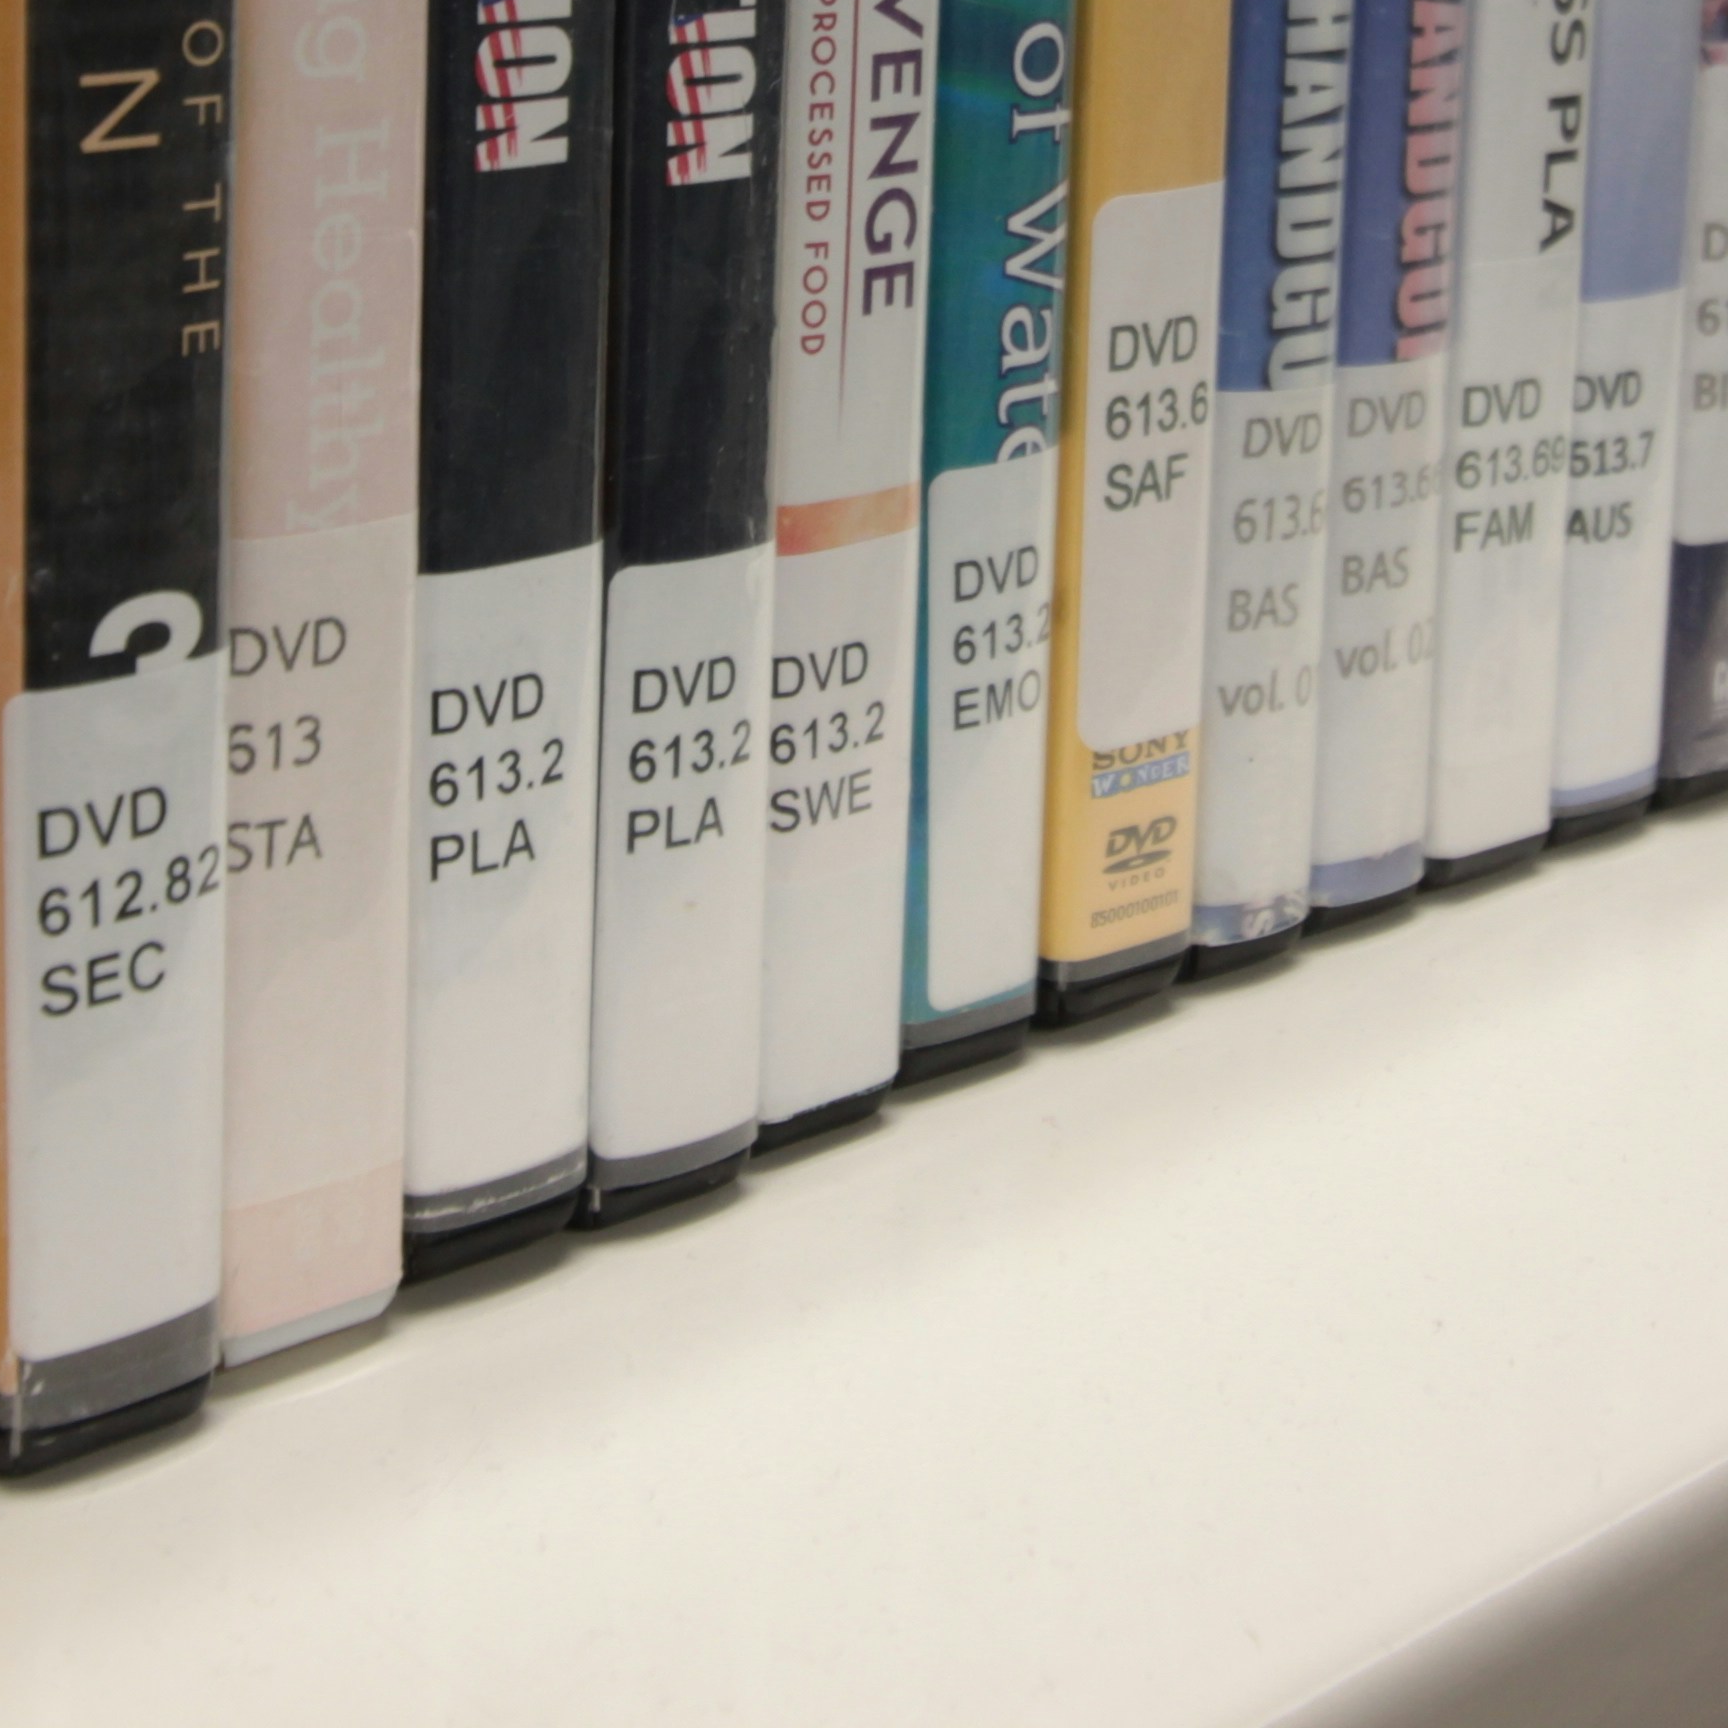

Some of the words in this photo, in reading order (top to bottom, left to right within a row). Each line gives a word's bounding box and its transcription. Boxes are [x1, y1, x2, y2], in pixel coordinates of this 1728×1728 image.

[182, 20, 225, 125] OF
[1538, 93, 1583, 253] PLA
[180, 182, 222, 357] THE
[286, 122, 390, 532] Healthy
[800, 243, 829, 356] FOOD
[1109, 316, 1198, 372] DVD
[1105, 381, 1208, 441] 613.6
[1347, 389, 1427, 438] DVD
[1461, 377, 1542, 429] DVD
[1572, 370, 1642, 414] DVD
[1243, 413, 1322, 459] DVD
[1455, 434, 1564, 489] 613.69
[1103, 453, 1189, 511] SAF
[1454, 501, 1534, 552] FAM
[1566, 501, 1634, 545] AUS
[954, 545, 1039, 602] DVD
[1341, 546, 1410, 595] BAS
[953, 602, 1051, 665] 613.2
[1227, 582, 1298, 633] BAS
[229, 616, 346, 676] DVD
[771, 642, 868, 699] DVD
[1337, 633, 1398, 678] vol.
[431, 672, 545, 737] DVD
[632, 656, 736, 714] DVD
[954, 669, 1041, 731] EMO
[228, 715, 322, 774] 613
[628, 720, 751, 783] 613.2
[770, 701, 886, 766] 613.2
[1093, 730, 1190, 770] SONY
[430, 738, 565, 808] 613.2
[769, 770, 873, 832] SWE
[37, 783, 169, 862] DVD
[227, 813, 323, 874] STA
[430, 819, 536, 882] PLA
[626, 798, 725, 854] PLA
[1106, 815, 1176, 858] DVD
[37, 843, 222, 938] 612.82
[1108, 867, 1166, 890] VIDEO
[39, 939, 167, 1019] SEC
